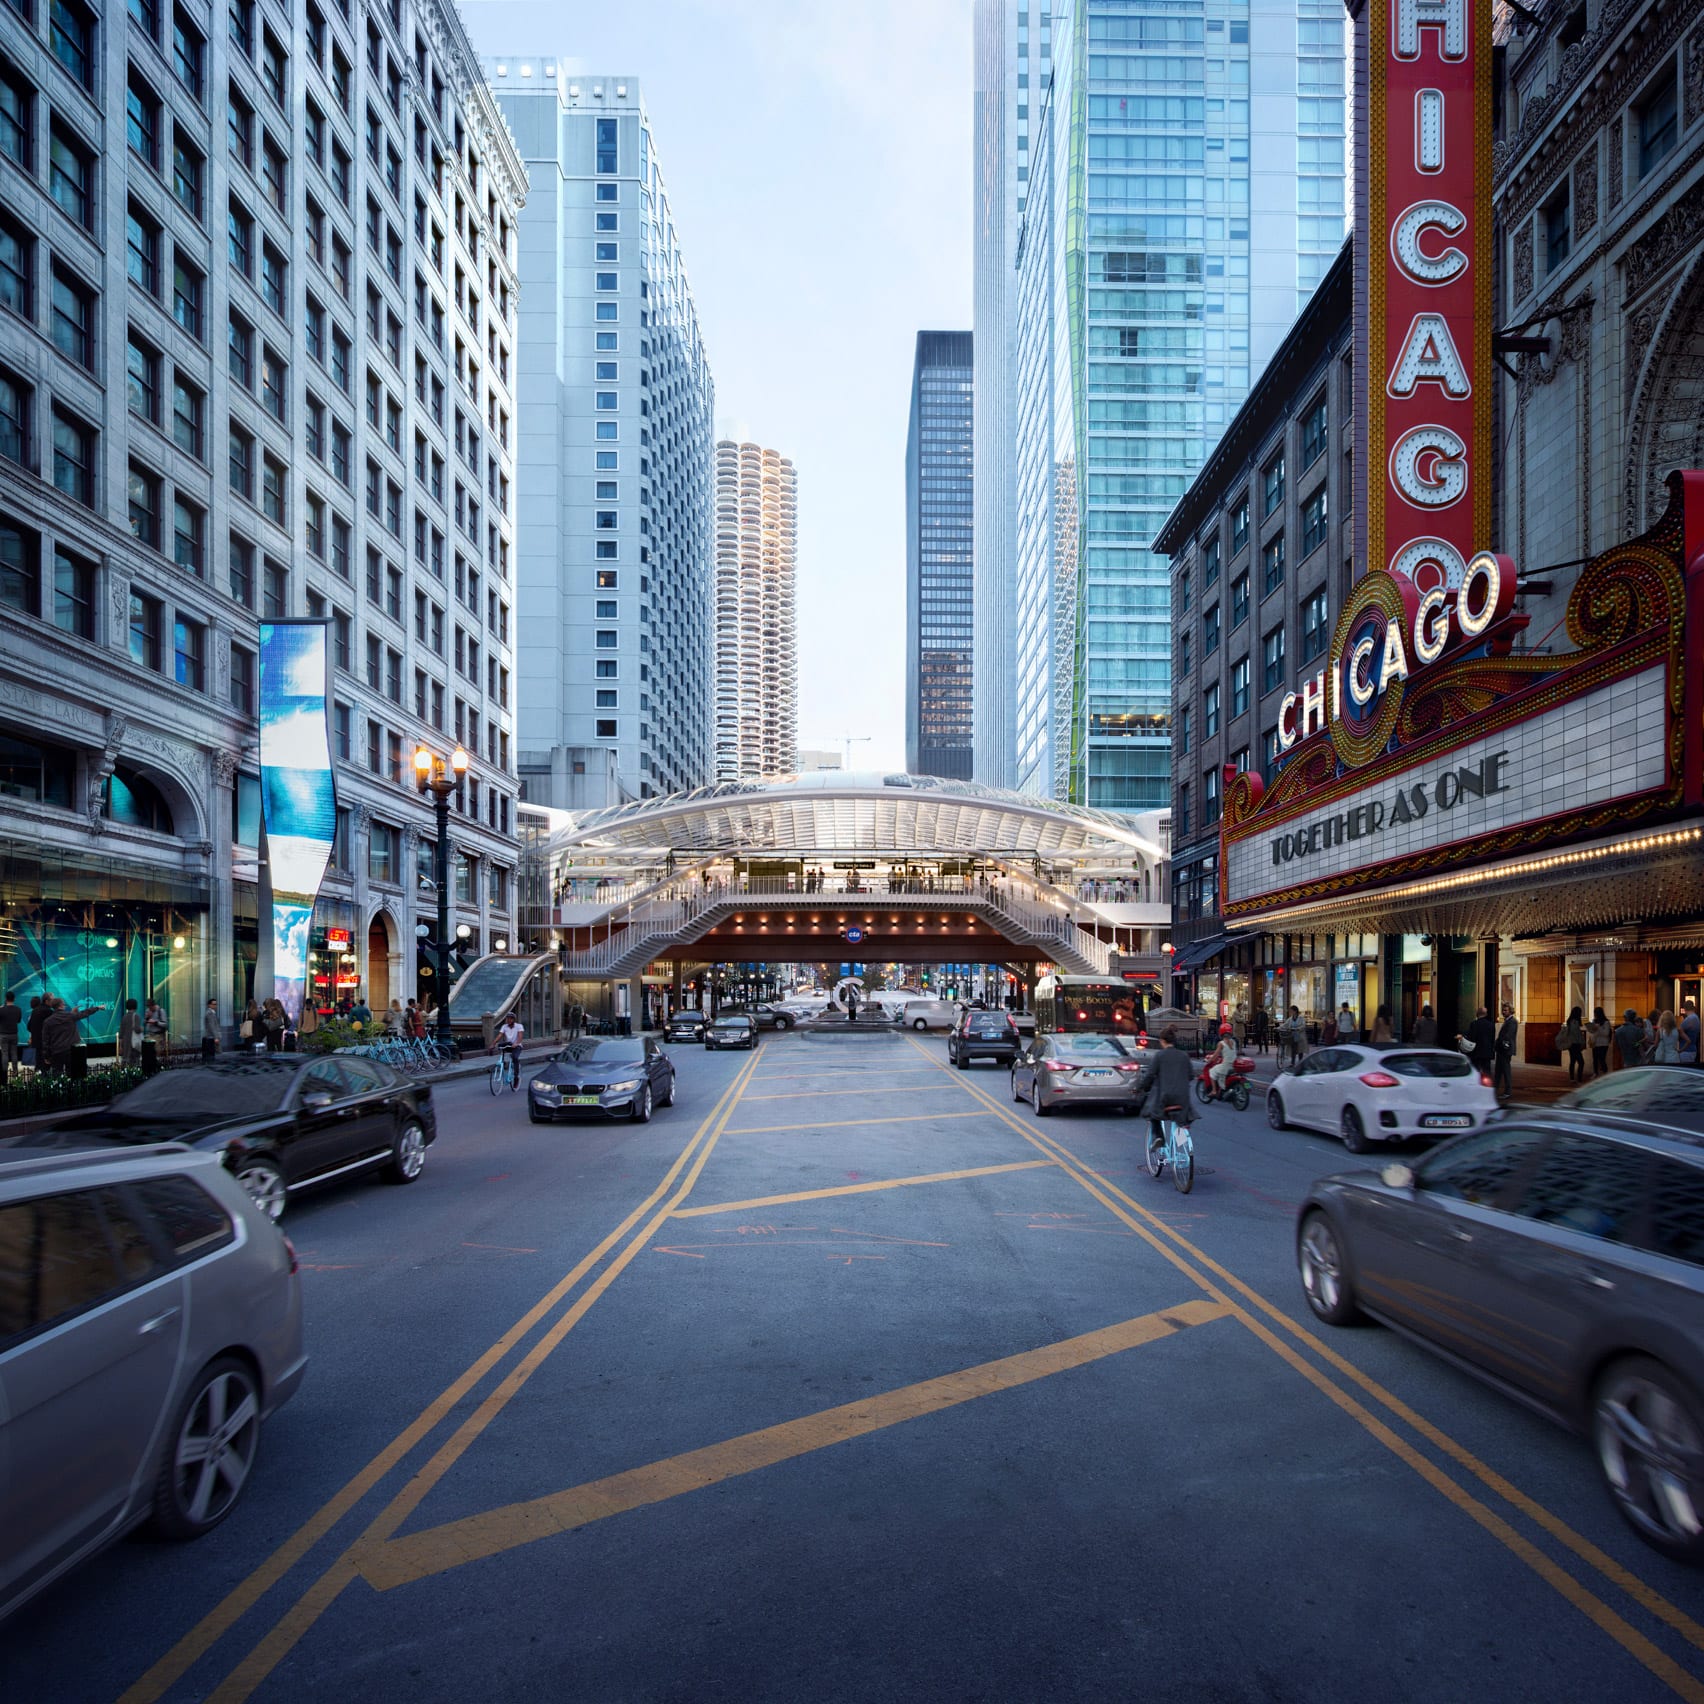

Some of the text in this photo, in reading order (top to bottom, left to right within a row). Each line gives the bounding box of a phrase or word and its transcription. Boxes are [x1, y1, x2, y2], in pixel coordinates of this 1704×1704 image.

[1278, 550, 1500, 749] CHICAGO
[1270, 750, 1511, 865] TOGETHER AS ONE
[95, 968, 115, 979] NEWS
